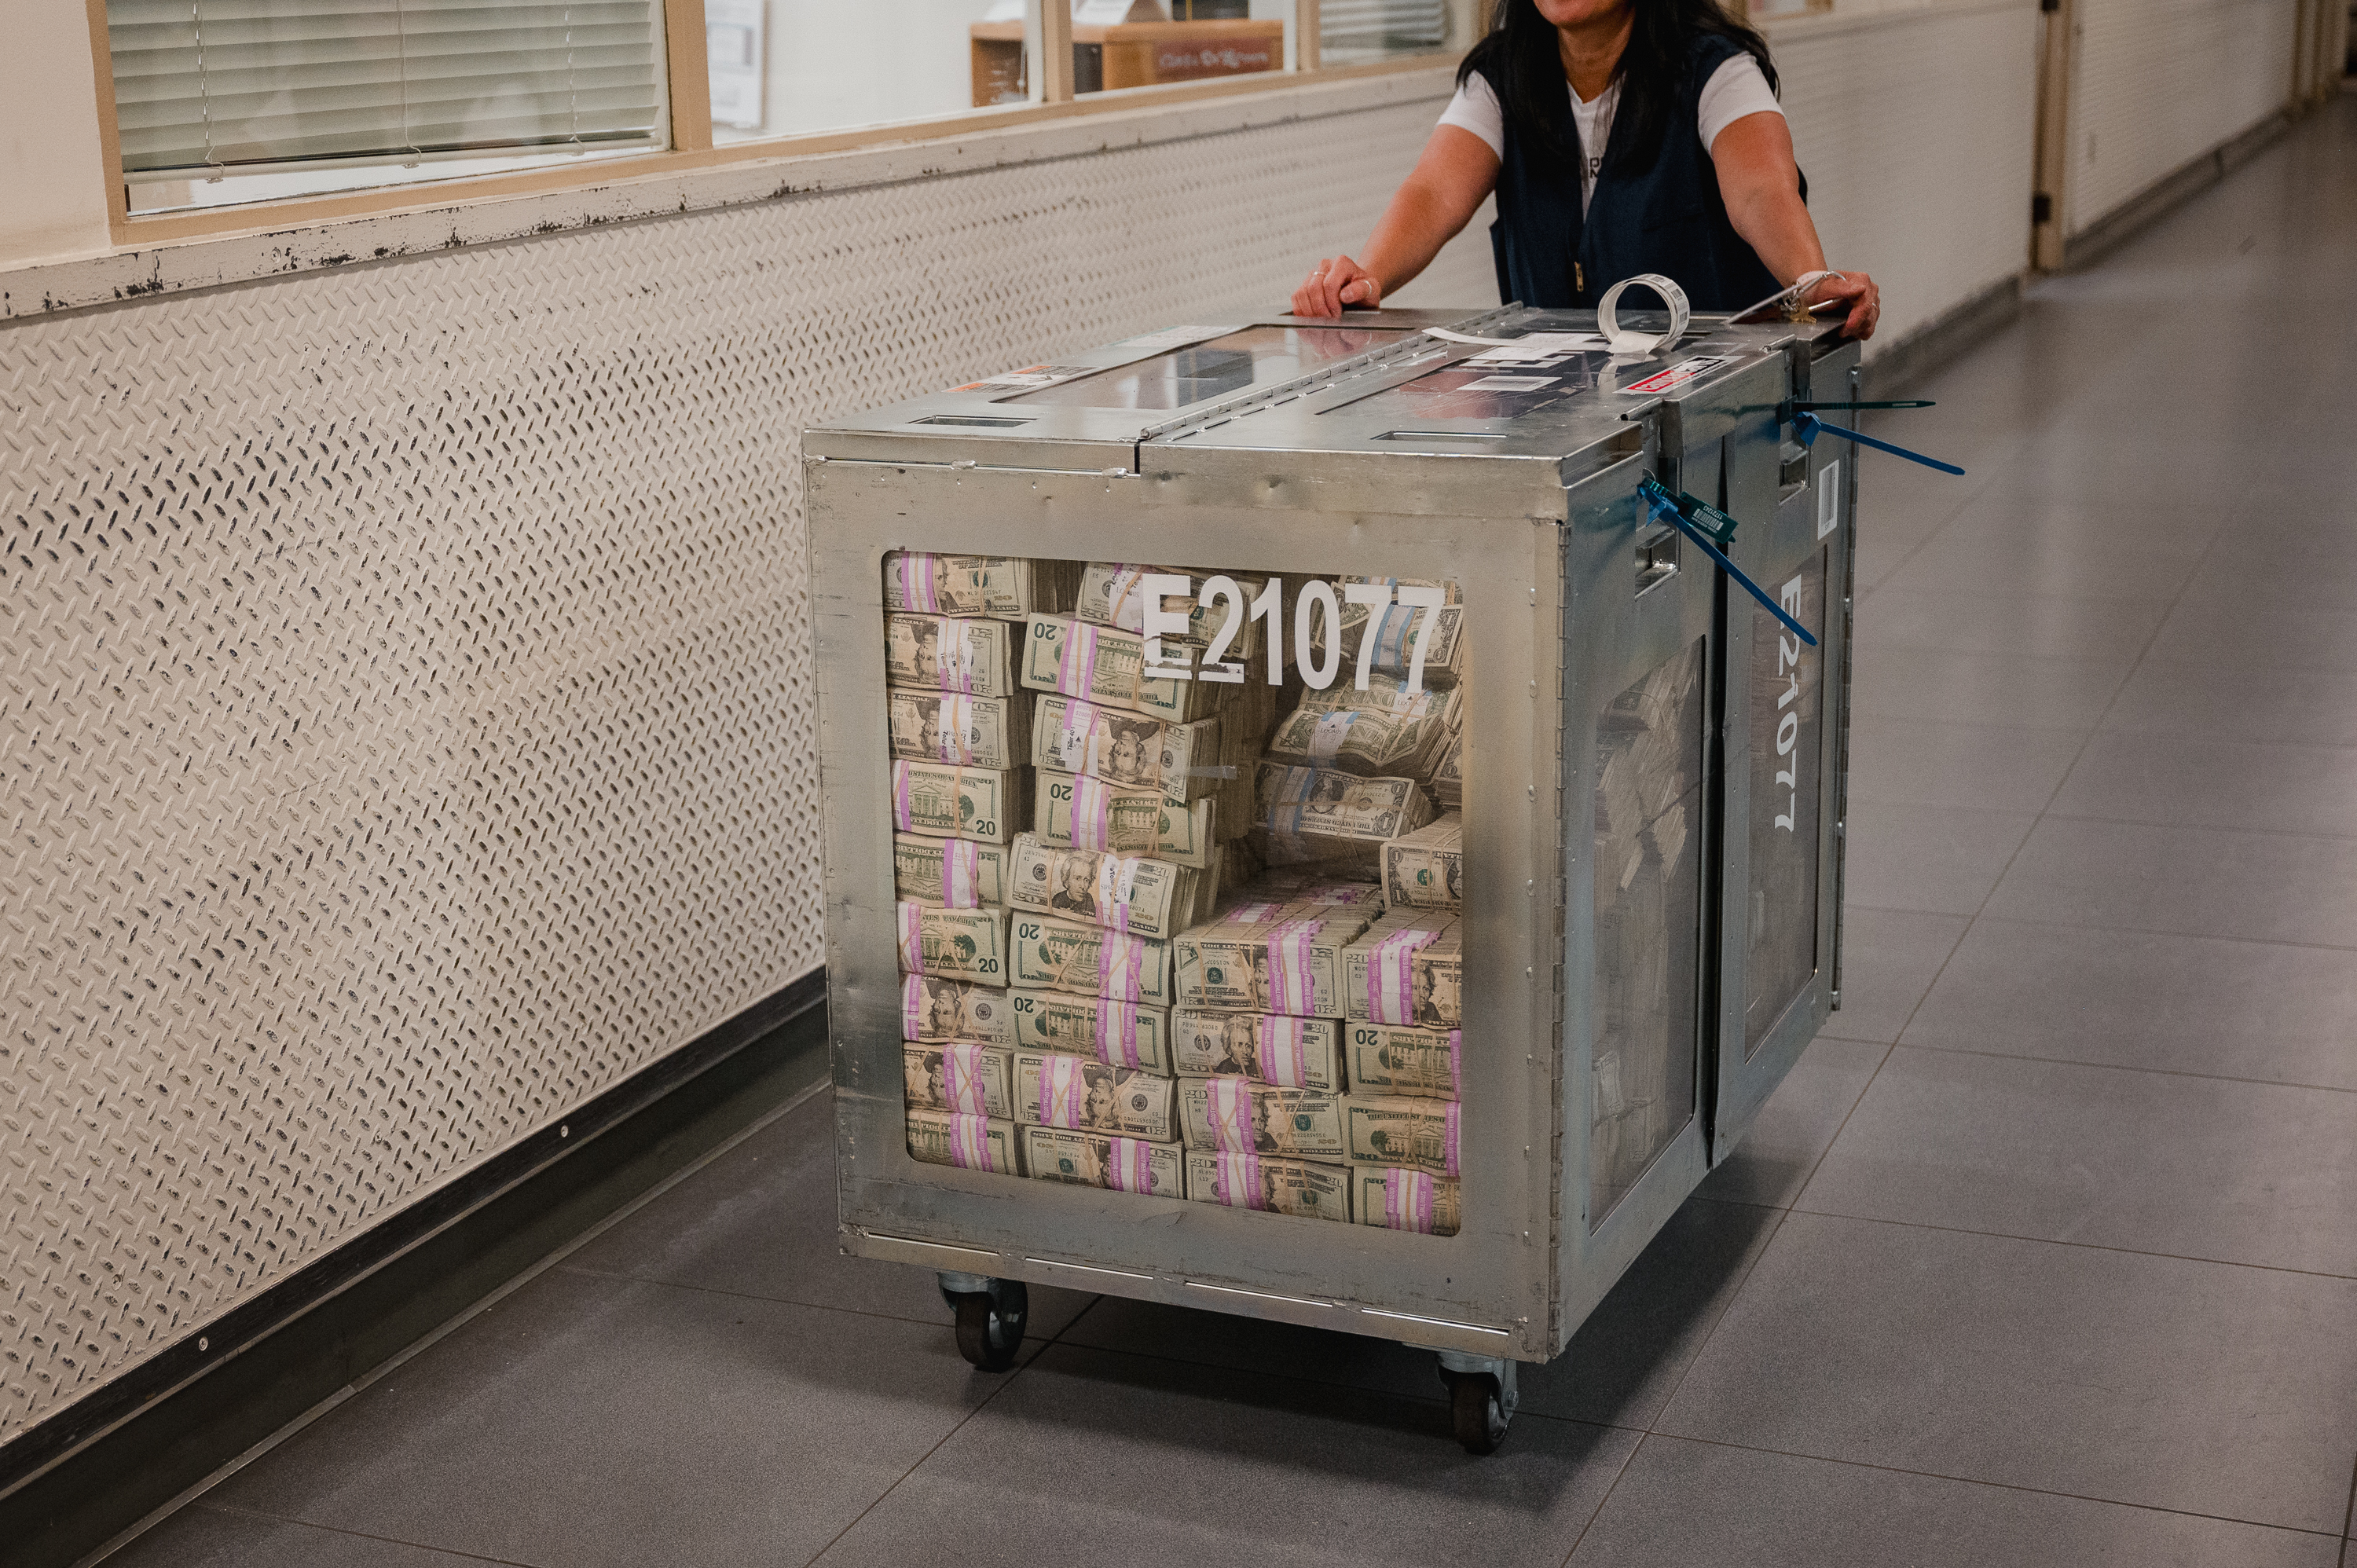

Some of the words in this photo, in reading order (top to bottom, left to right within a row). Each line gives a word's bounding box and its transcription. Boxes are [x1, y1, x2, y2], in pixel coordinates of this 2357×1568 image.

[1703, 505, 1723, 520] 11721243
[1034, 622, 1057, 640] 20
[1142, 573, 1446, 693] E21077
[1775, 574, 1802, 832] E21077
[1050, 783, 1072, 800] 20
[976, 819, 996, 836] 20
[1153, 866, 1169, 877] 20
[1019, 923, 1039, 940] 20
[979, 958, 999, 973] 20
[1014, 997, 1034, 1013] 20
[1310, 1023, 1329, 1034] 20
[1355, 1029, 1378, 1046] 20
